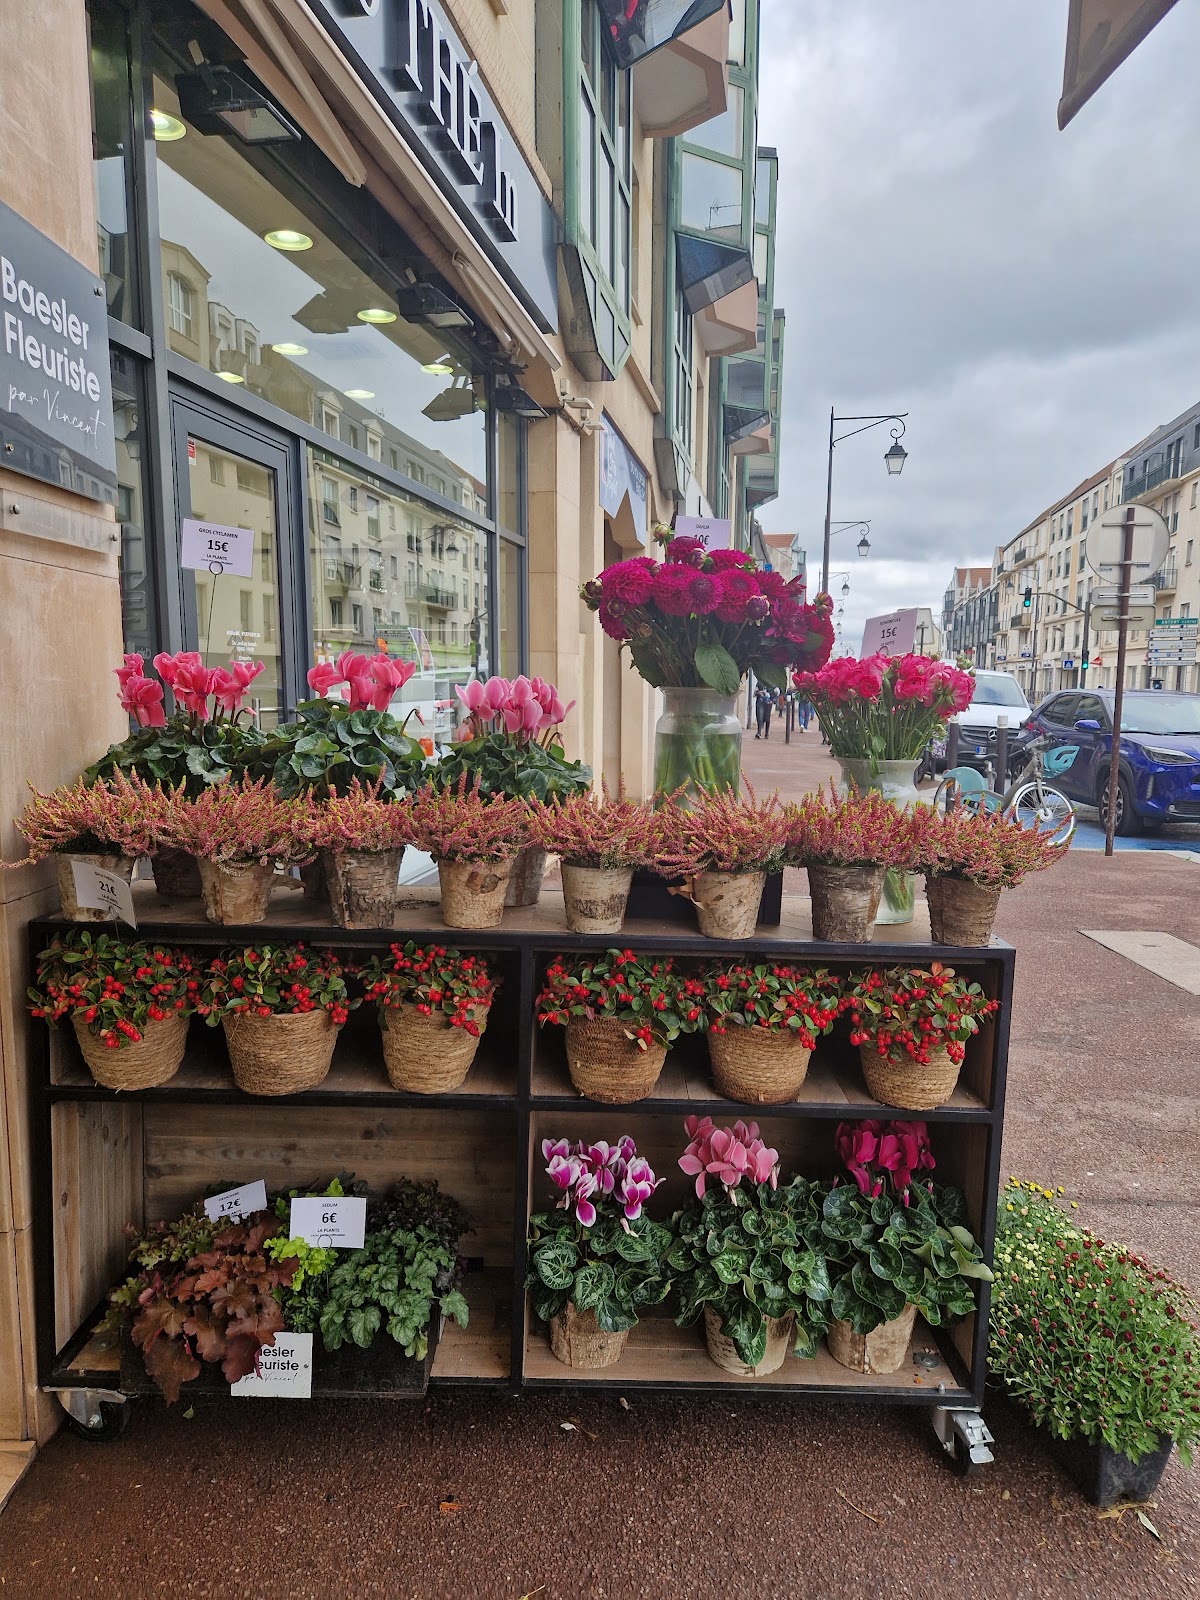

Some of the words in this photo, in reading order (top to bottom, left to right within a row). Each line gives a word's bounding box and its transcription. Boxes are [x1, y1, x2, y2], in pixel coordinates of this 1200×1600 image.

[1, 256, 90, 351] Baesler
[5, 311, 101, 402] Fleuriste
[9, 384, 39, 413] par
[44, 389, 105, 449] Vincent
[198, 527, 212, 535] GROS
[212, 530, 239, 539] CYCLAMEN
[207, 539, 229, 552] 15€
[881, 627, 898, 639] 15€
[99, 881, 117, 897] 21€
[219, 1198, 242, 1213] 12€
[322, 1212, 338, 1224] 6€
[259, 1346, 295, 1358] esler
[258, 1359, 300, 1371] euriste
